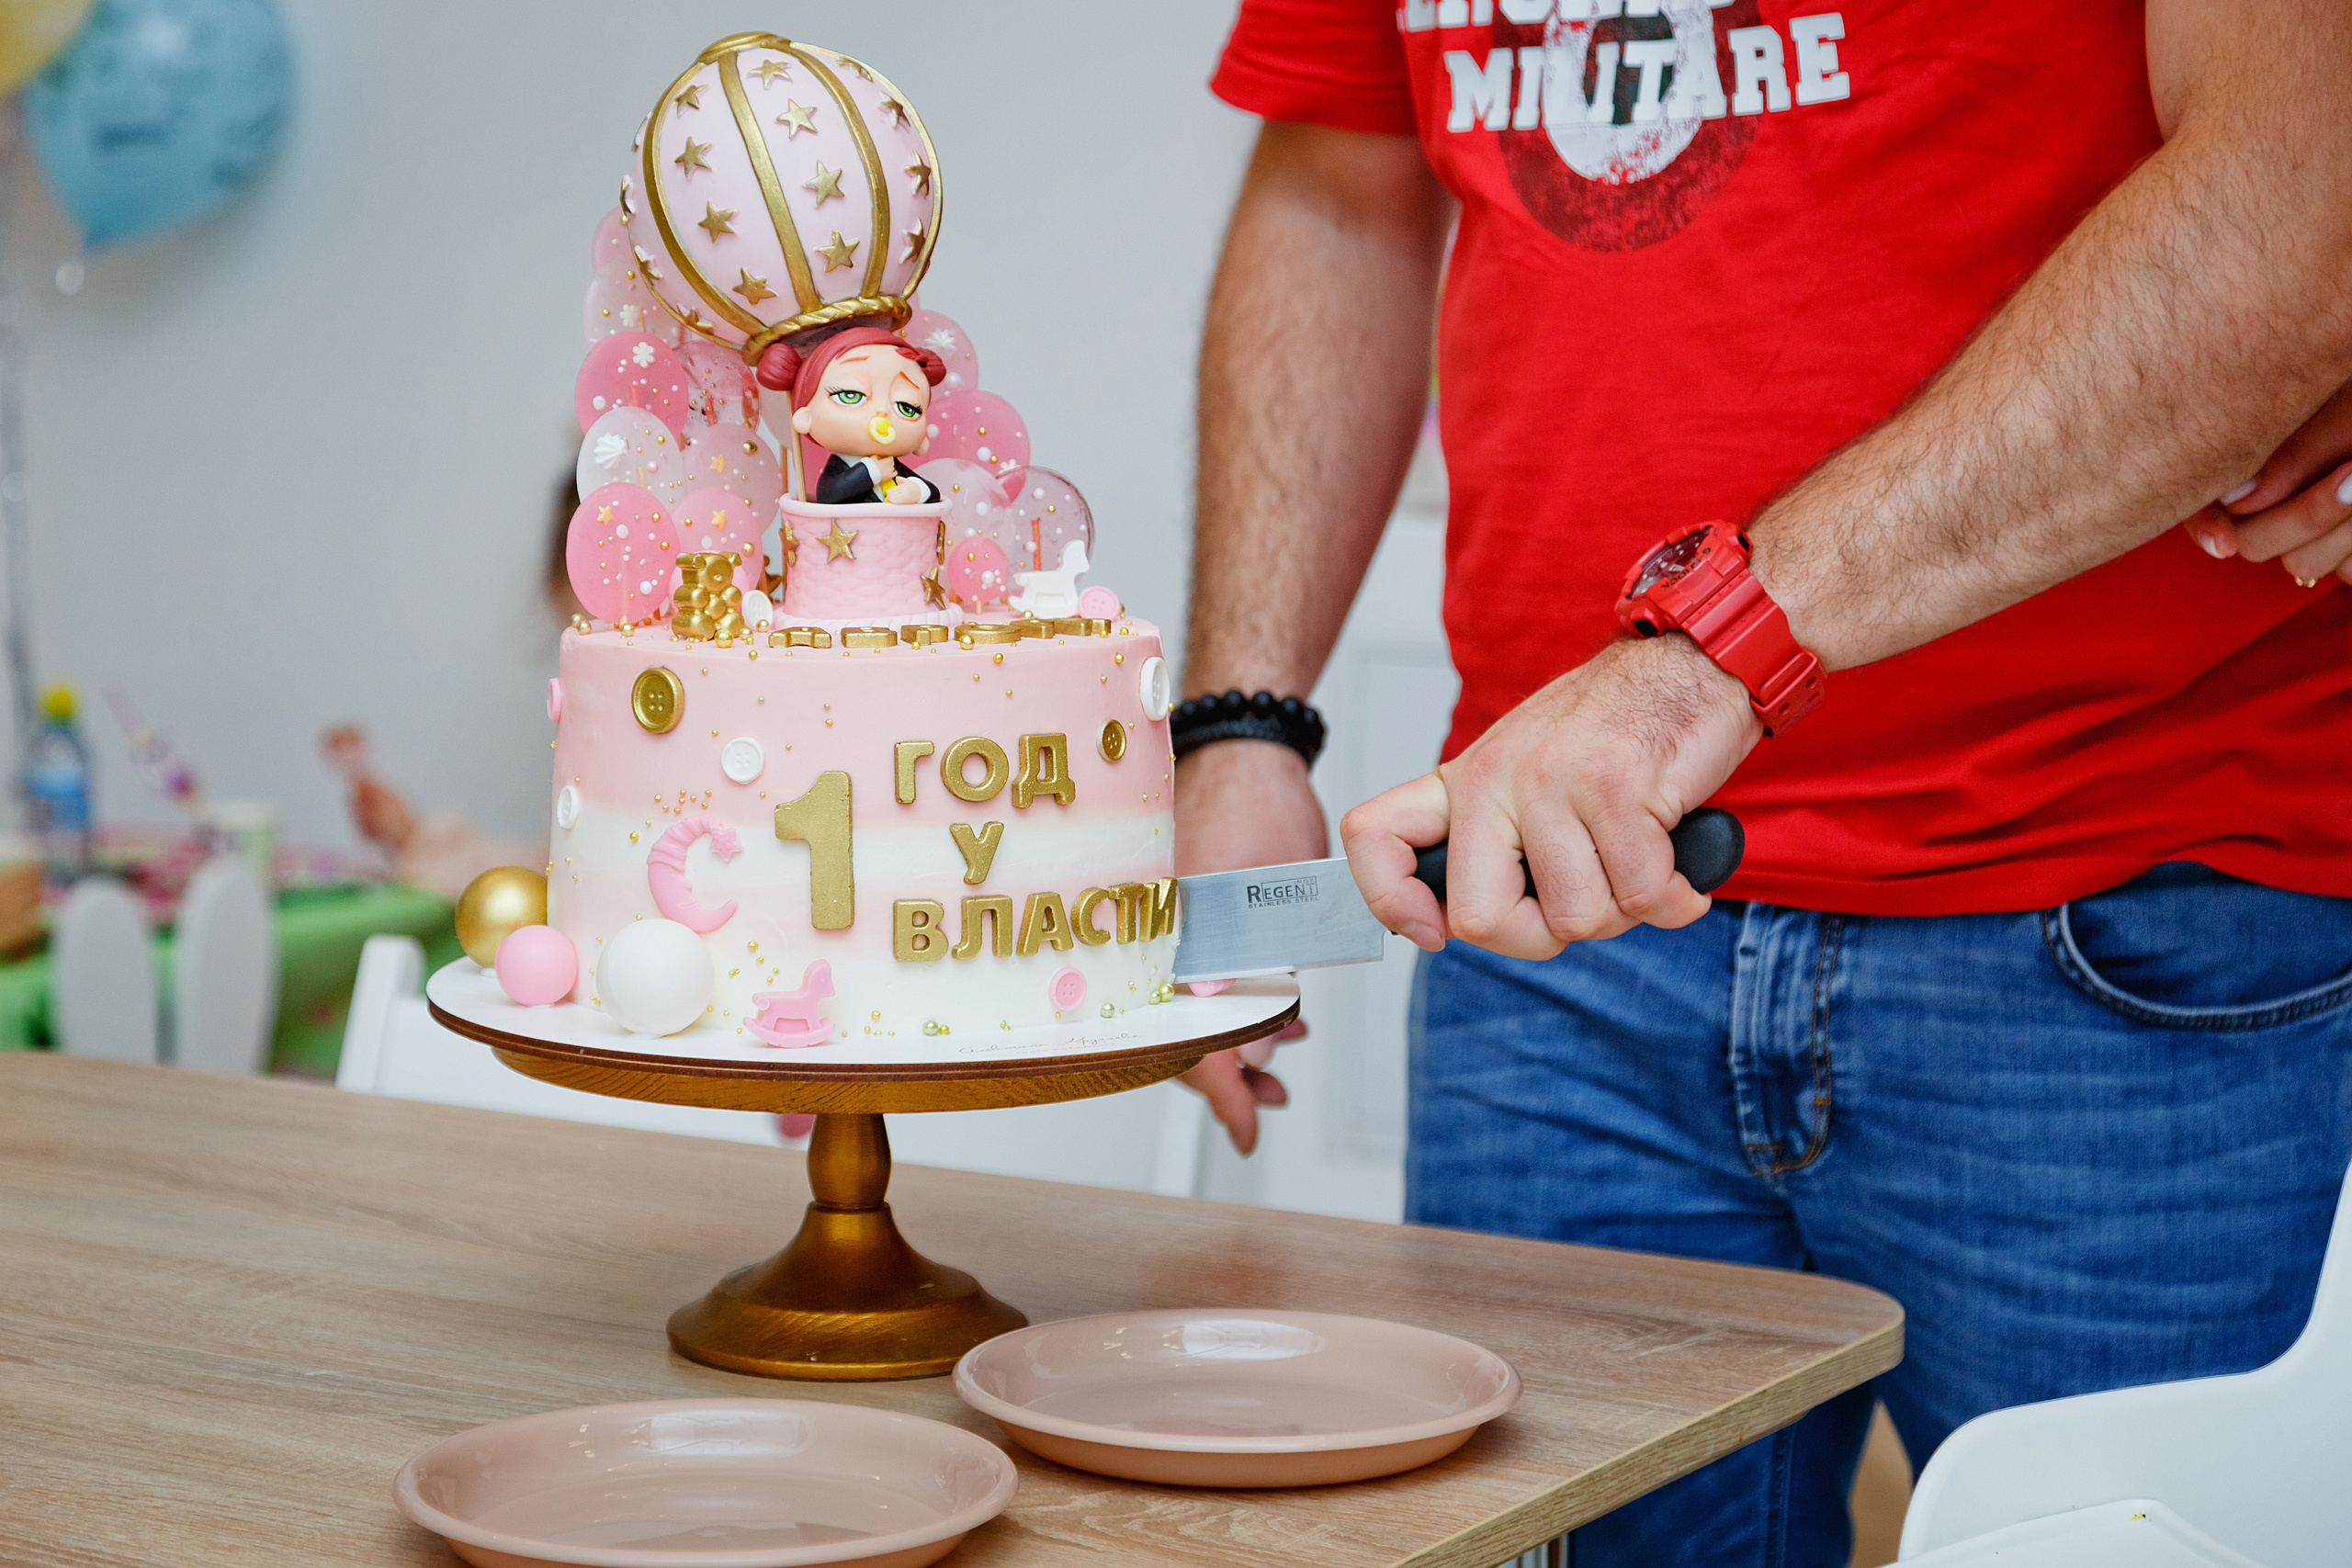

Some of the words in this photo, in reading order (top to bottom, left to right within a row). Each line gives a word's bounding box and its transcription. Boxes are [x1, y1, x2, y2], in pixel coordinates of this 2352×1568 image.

[1444, 12, 1850, 132] MILITARE
[775, 771, 854, 930] 1
[894, 733, 1076, 808] ГОД
[949, 821, 1004, 886] У
[893, 877, 1178, 962] ВЛАСТИ
[1249, 900, 1292, 908] STAINLESS
